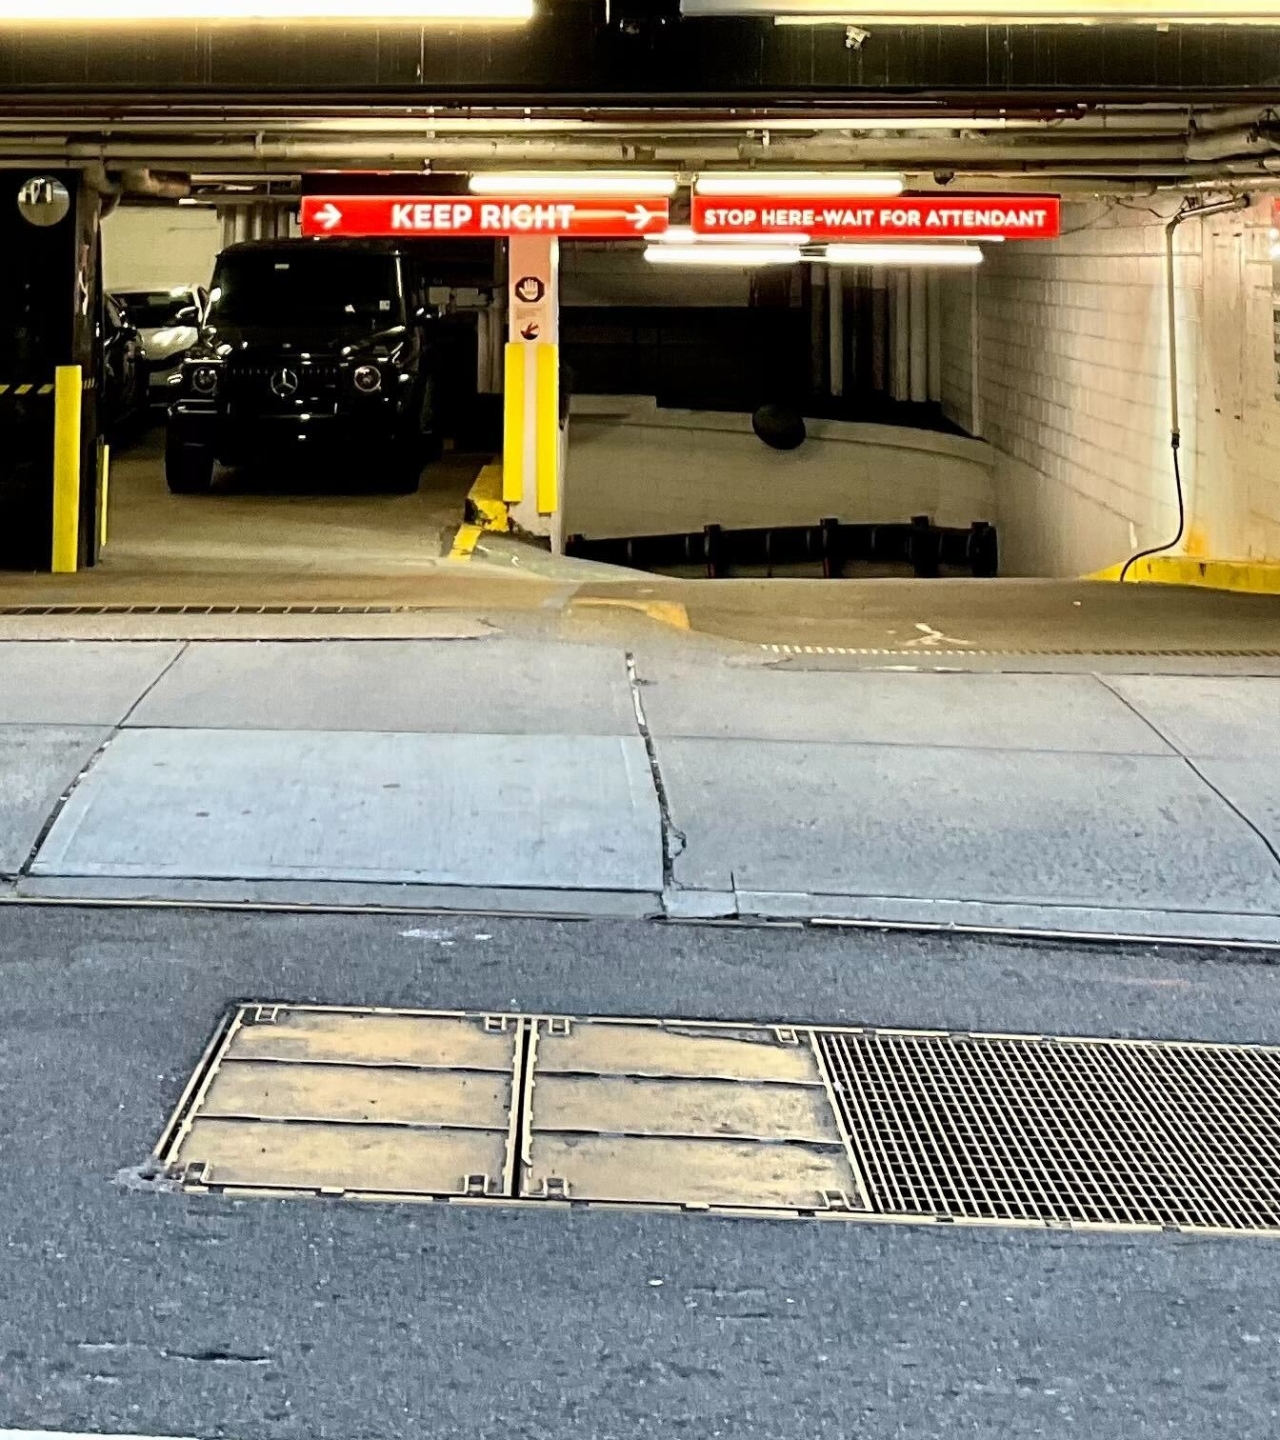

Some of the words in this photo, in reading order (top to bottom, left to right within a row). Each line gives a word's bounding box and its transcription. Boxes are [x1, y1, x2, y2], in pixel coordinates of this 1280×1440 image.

[391, 204, 472, 229] KEEP
[479, 204, 575, 229] RIGHT
[704, 209, 756, 226] STOP
[879, 209, 921, 227] FOR
[925, 210, 1046, 227] ATTENDANT
